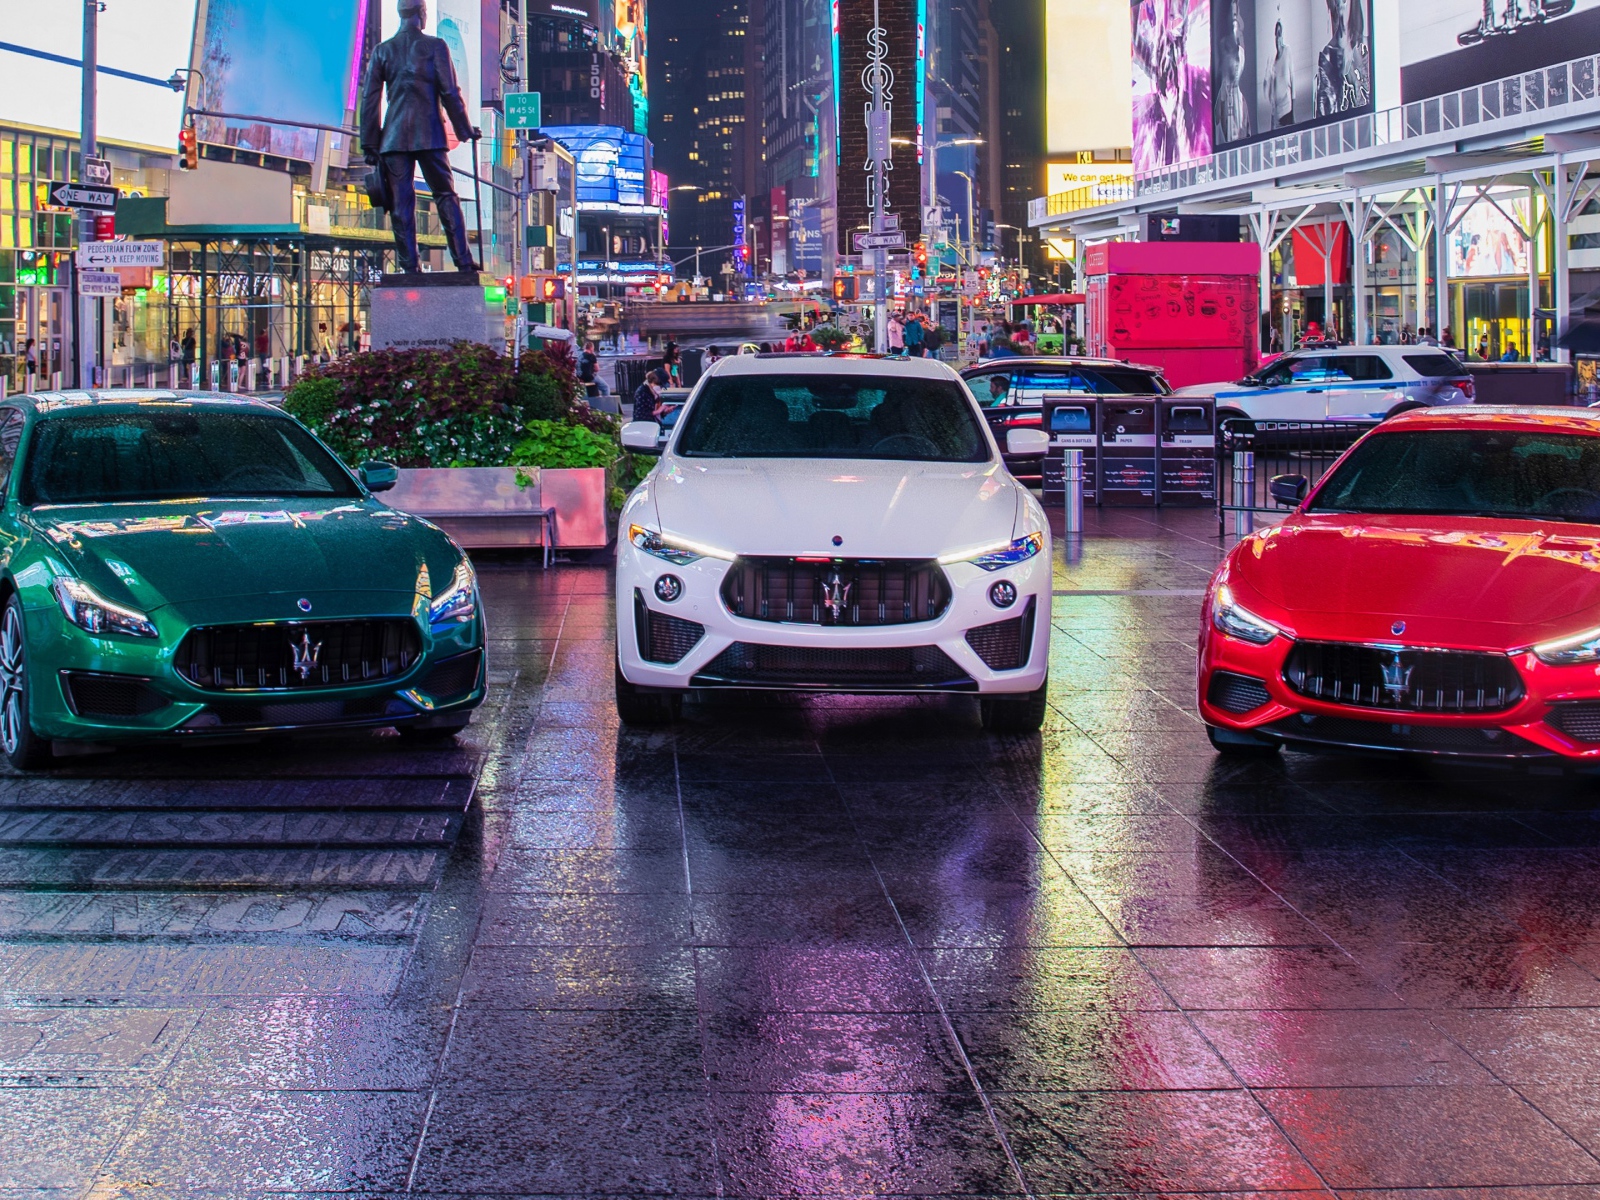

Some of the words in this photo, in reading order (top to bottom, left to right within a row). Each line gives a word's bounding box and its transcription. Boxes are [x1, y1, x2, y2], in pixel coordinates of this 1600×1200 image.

[590, 53, 600, 99] 1500
[1063, 173, 1078, 182] We
[1080, 174, 1097, 182] can
[1100, 174, 1114, 184] get
[59, 189, 79, 200] ONE
[88, 192, 110, 203] WAY
[87, 245, 124, 254] PEDESTRIAN
[125, 244, 141, 253] FLOW
[143, 244, 159, 253] ZONE
[119, 255, 134, 263] KEEP
[135, 254, 159, 263] MOVING
[966, 280, 977, 288] 25
[93, 851, 438, 883] GERSHWIN
